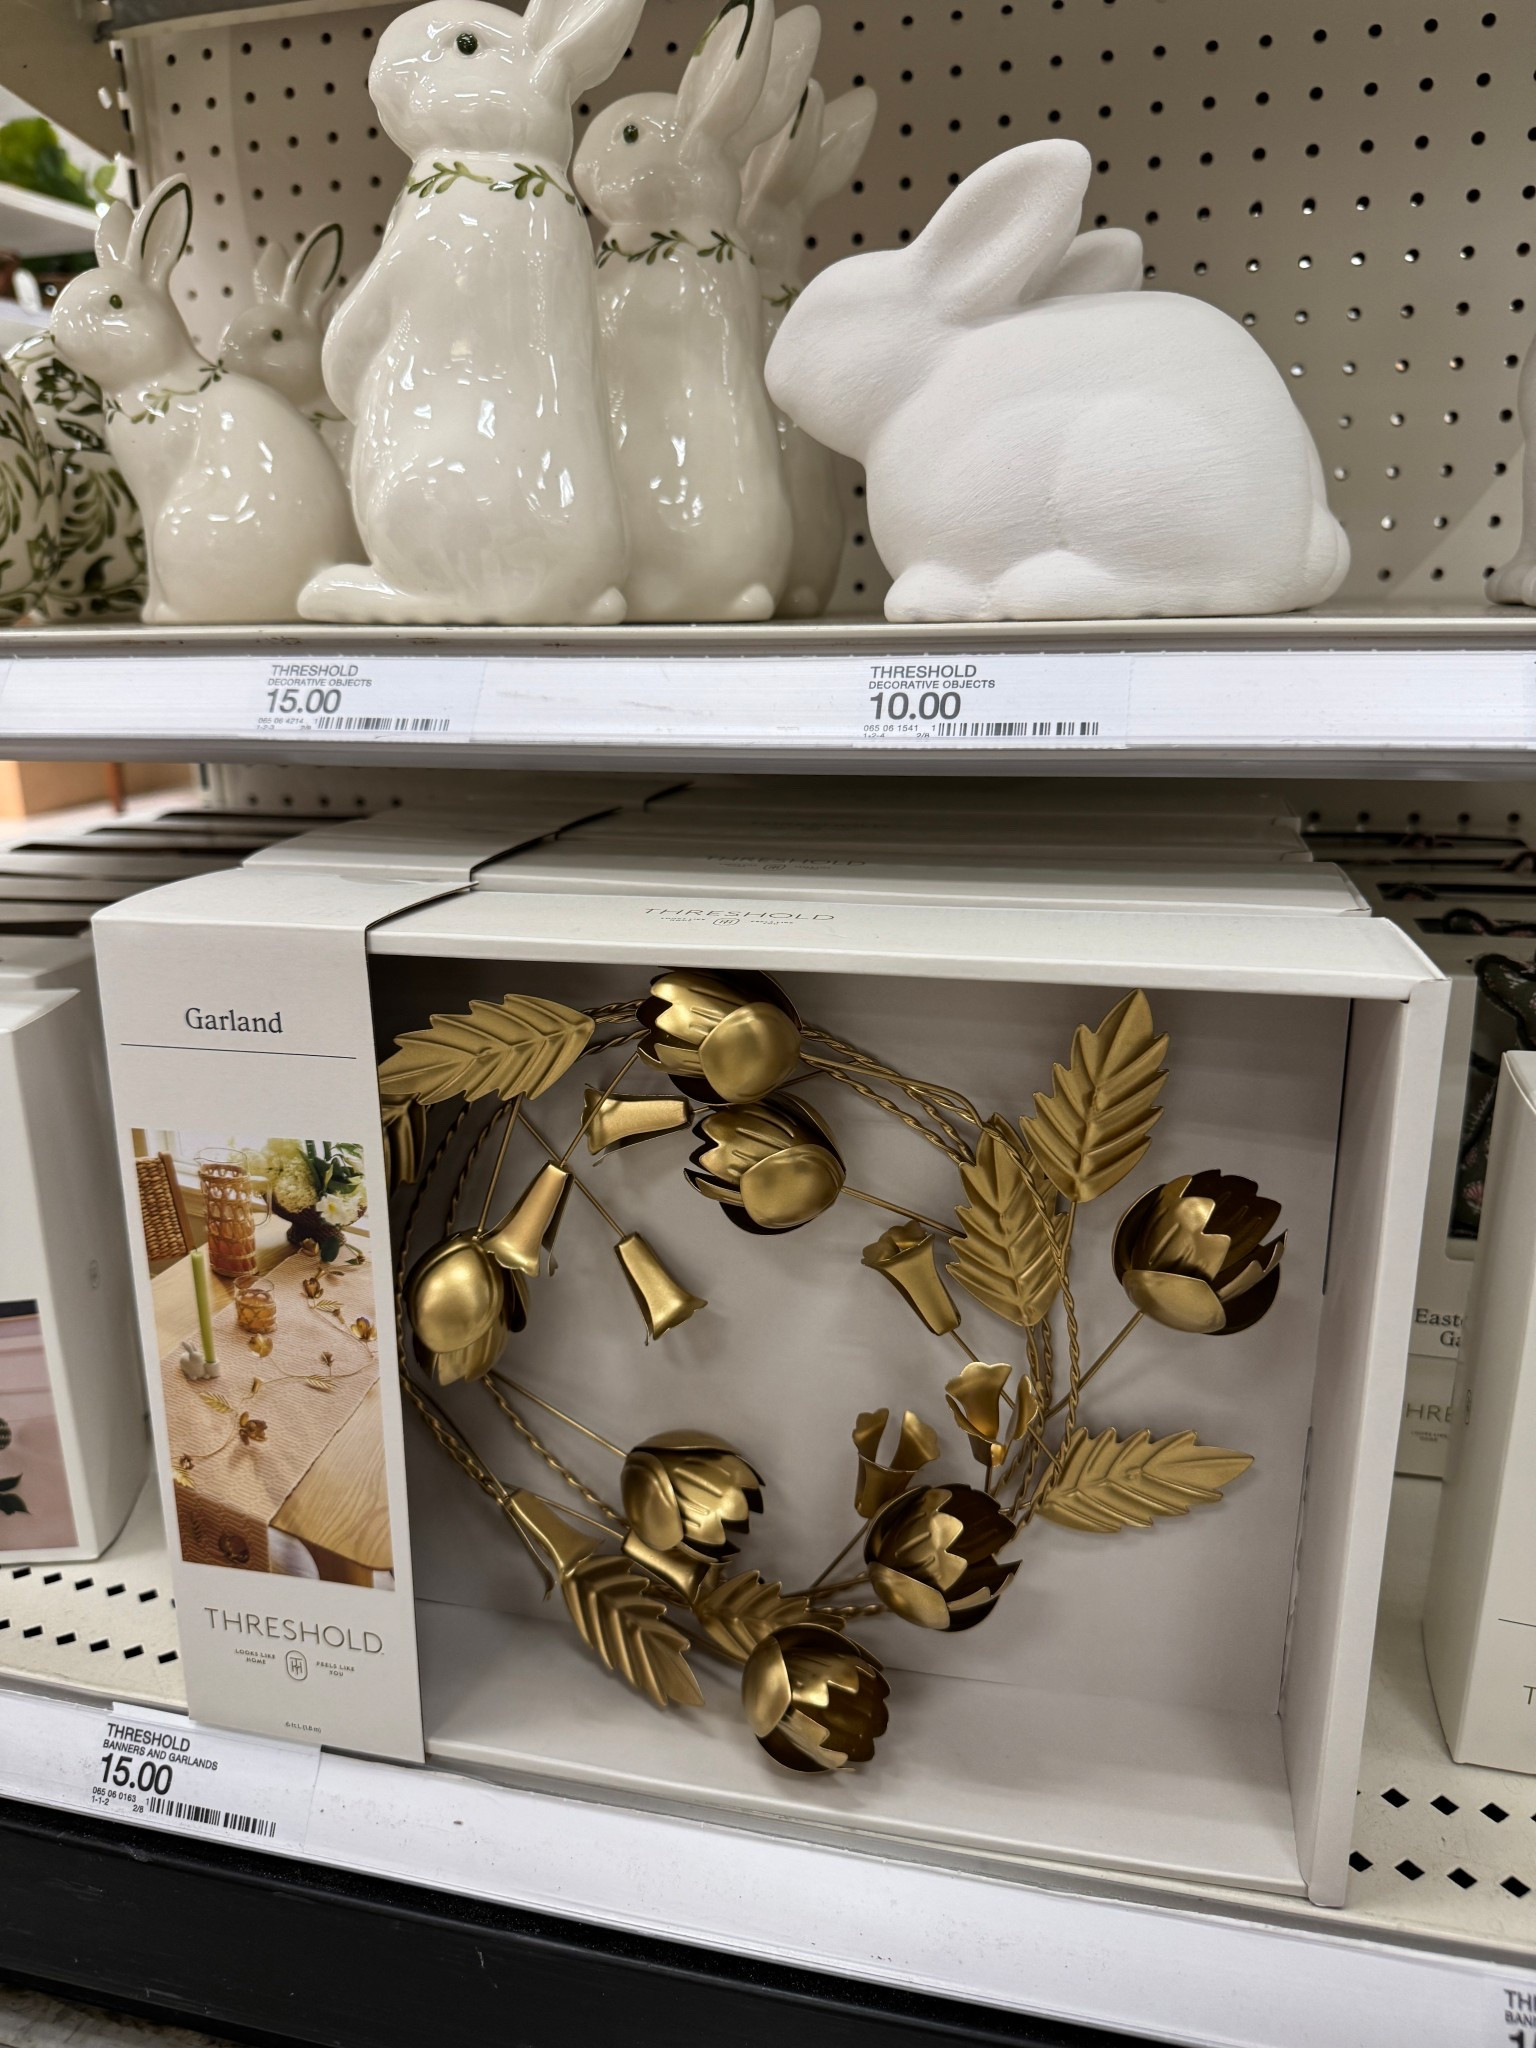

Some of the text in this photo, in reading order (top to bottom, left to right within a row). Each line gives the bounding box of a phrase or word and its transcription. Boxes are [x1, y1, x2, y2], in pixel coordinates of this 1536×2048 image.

[272, 665, 359, 677] THRESHOLD
[870, 664, 977, 678] THRESHOLD
[267, 679, 372, 687] DECORATIVE OBJECTS
[868, 680, 996, 690] DECORATIVE OBJECTS
[267, 688, 342, 714] 15.00
[869, 691, 961, 720] 10.00
[863, 724, 880, 732] 065
[883, 724, 894, 732] 06
[897, 724, 918, 732] 1541
[645, 908, 835, 921] THRESHOLD
[185, 1007, 284, 1034] Garland
[204, 1607, 384, 1654] THRESHOLD
[235, 1648, 276, 1660] LOOKS LIKE
[246, 1656, 267, 1665] HOME
[316, 1661, 355, 1672] FEELS LIKE
[107, 1723, 190, 1752] THRESHOLD
[102, 1739, 219, 1771] BANNERS AND GARLANDS
[101, 1753, 174, 1796] 15.00
[92, 1786, 106, 1796] 065
[107, 1789, 117, 1799] 06
[118, 1792, 137, 1803] 0163
[91, 1795, 144, 1814] 1-1-2 2/8
